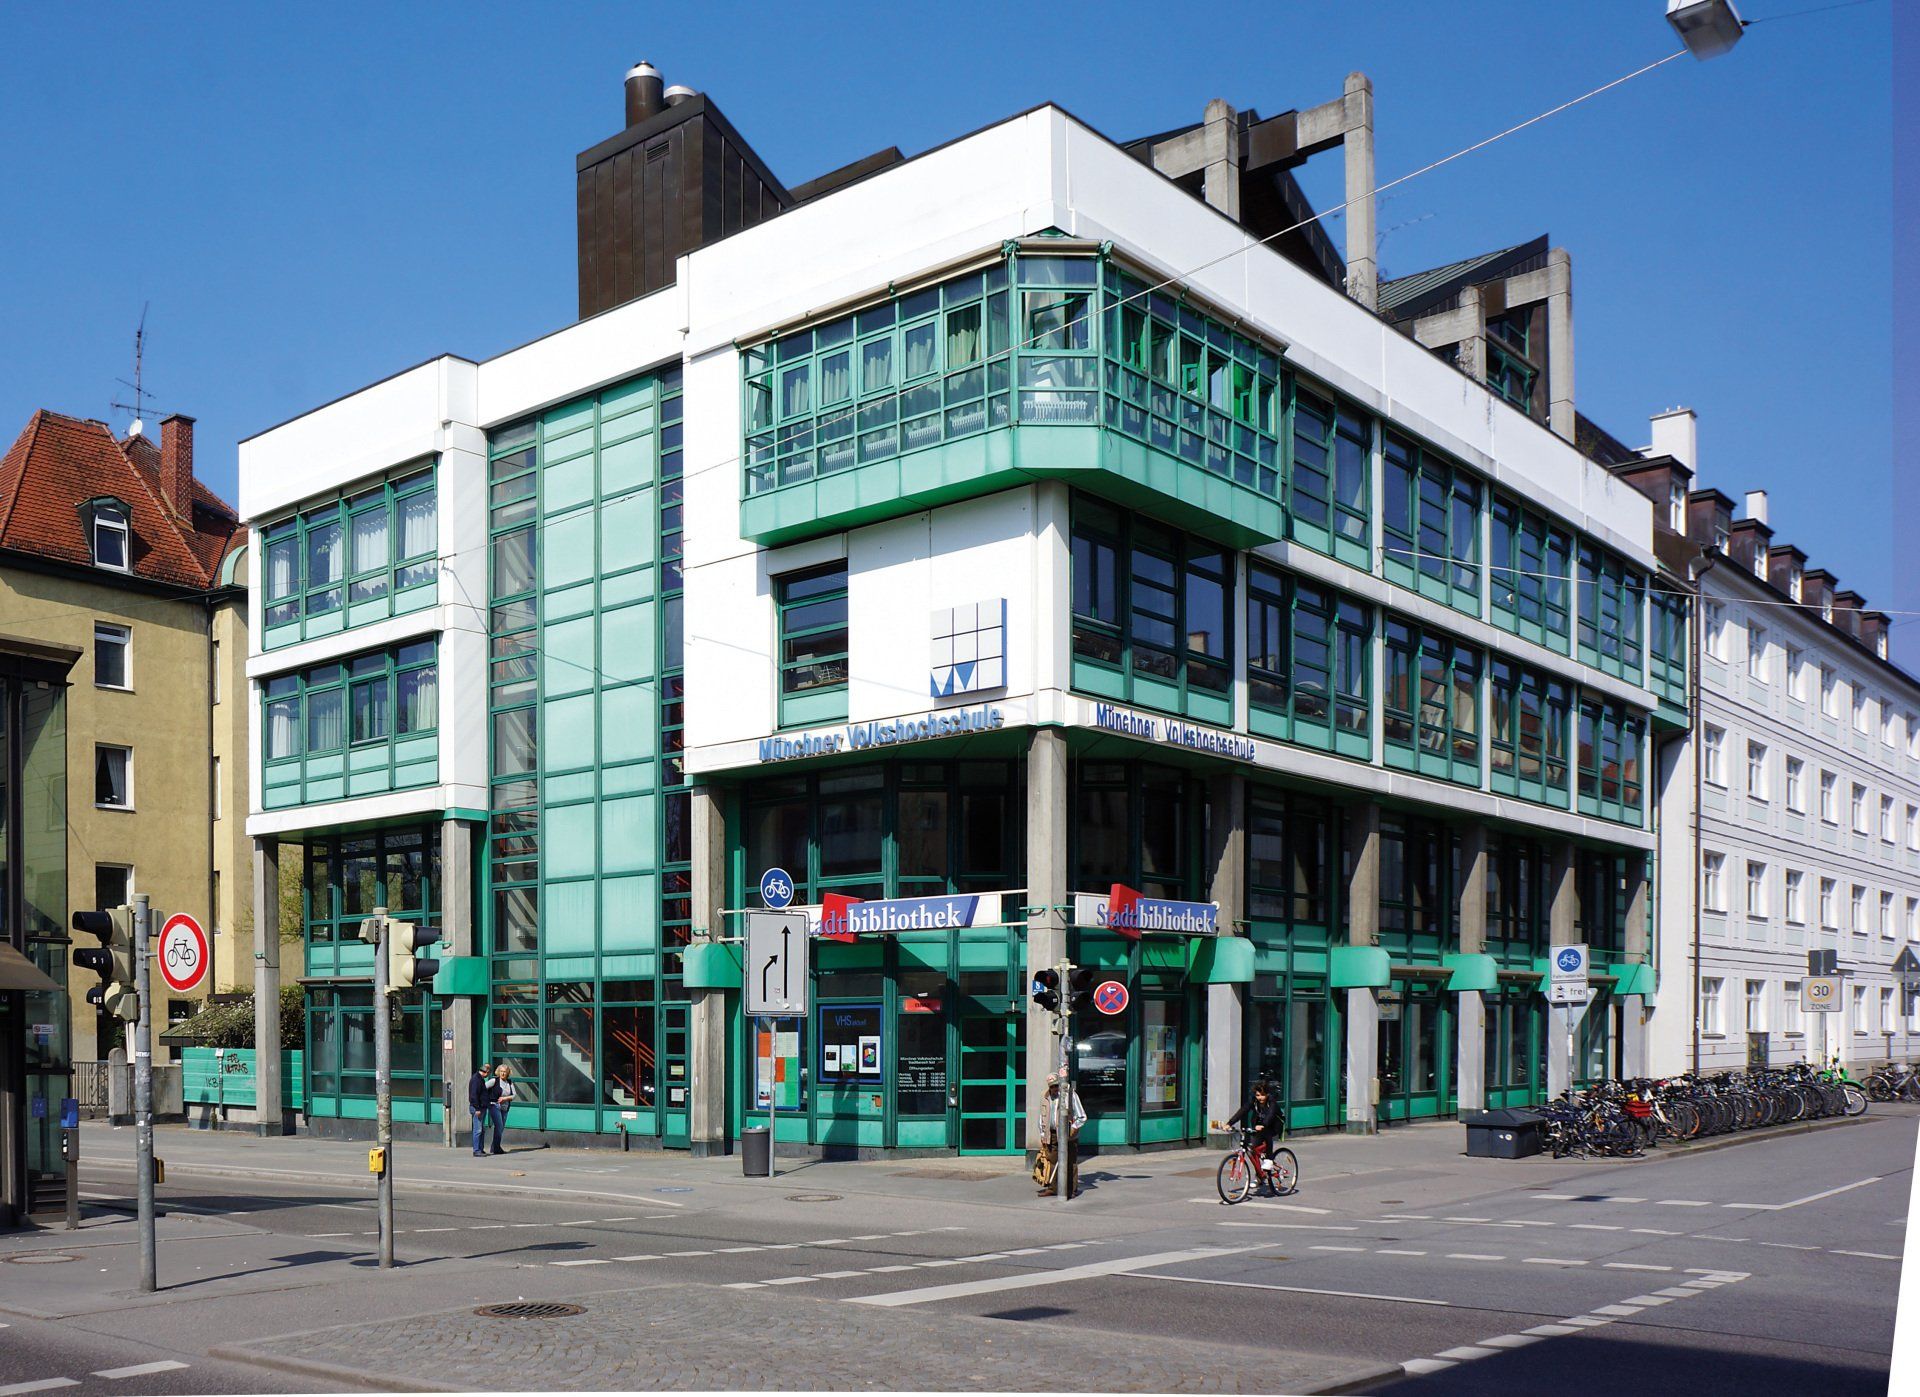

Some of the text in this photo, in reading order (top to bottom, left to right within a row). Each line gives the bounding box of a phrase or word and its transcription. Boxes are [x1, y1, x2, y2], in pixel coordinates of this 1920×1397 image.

[759, 704, 1003, 763] Münchner Volkshochschule
[1096, 702, 1255, 761] Münchner Volkshochschule
[1096, 903, 1212, 933] Stadtbibliothek
[1570, 988, 1586, 996] frei
[1812, 985, 1830, 997] 30
